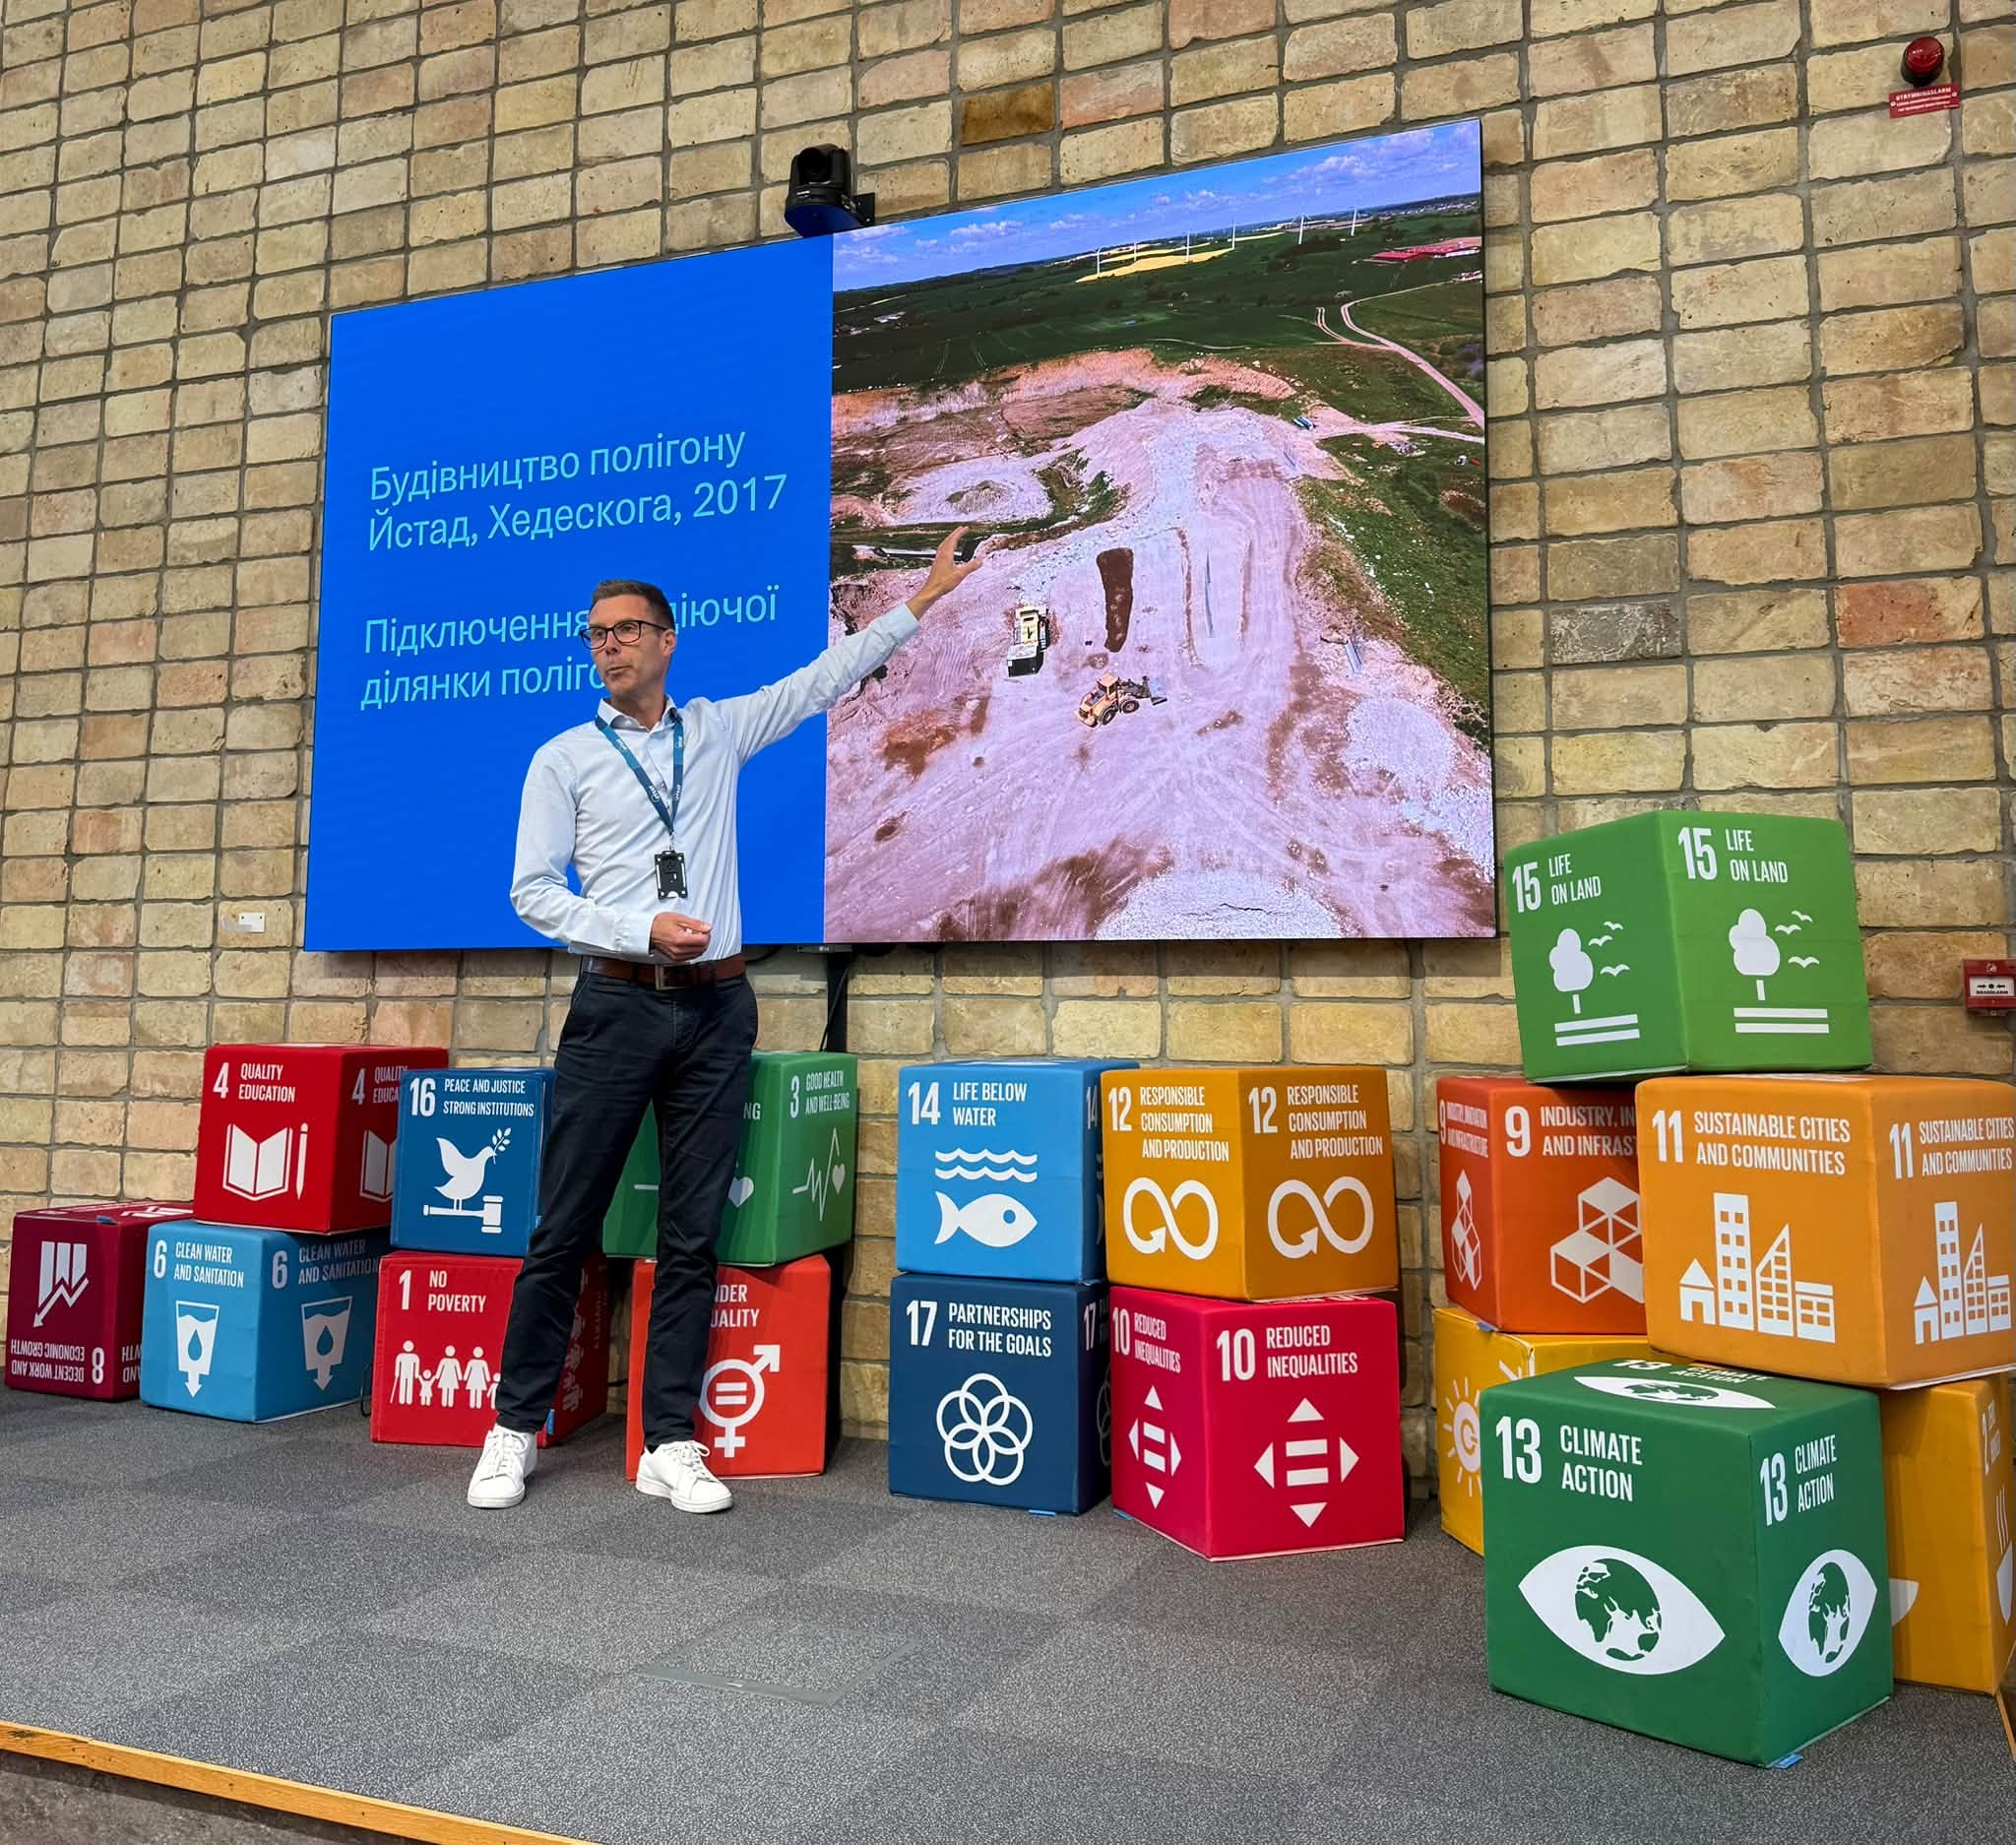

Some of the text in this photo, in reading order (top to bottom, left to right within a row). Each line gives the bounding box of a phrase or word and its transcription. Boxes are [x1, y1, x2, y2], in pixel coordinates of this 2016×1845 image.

[370, 431, 746, 506] Будівництво полігону
[369, 474, 787, 551] Йстад, Хедескога, 2017
[365, 609, 591, 657] Підключення
[360, 656, 605, 711] ділянки поліго
[1677, 826, 1754, 880] 15 LIFE
[1730, 859, 1789, 883] ON LAND
[1512, 854, 1572, 914] 15 LIFE
[1551, 875, 1602, 905] ON LAND
[213, 1062, 284, 1099] 4 QUALITY
[238, 1084, 295, 1103] EDUCATION
[351, 1068, 366, 1105] 4
[373, 1087, 400, 1104] EDUCA
[410, 1077, 526, 1116] 16 PEACE AND JUSTICE
[790, 1070, 844, 1118] 3 GOOD HEALTH
[443, 1101, 535, 1117] STRONG INSTITUTIONS
[805, 1092, 850, 1114] AND WELL-BEING
[908, 1081, 1028, 1125] 14 LIFE BELOW
[953, 1107, 996, 1126] WATER
[1086, 1084, 1098, 1130] 14
[1108, 1087, 1205, 1131] 12 RESPONSIBLE
[1248, 1084, 1358, 1134] 12 RESPONSIBLE
[1289, 1111, 1367, 1132] CONSUMPTION
[1141, 1113, 1213, 1133] CONSUMPTION
[1504, 1105, 1531, 1158] 9
[1653, 1110, 1683, 1163] 11
[1694, 1111, 1796, 1139] SUSTAINABLE
[1800, 1116, 1851, 1143] CITIES
[1142, 1138, 1228, 1162] AND PRODUCTION
[1291, 1136, 1383, 1160] AND PRODUCTION
[1543, 1135, 1575, 1156] AND
[1696, 1142, 1846, 1176] AND COMMUNITIES
[1890, 1116, 2015, 1179] 11 SUSTAINABLE CITIES
[1922, 1148, 2013, 1177] AND COMMUNITIES
[154, 1240, 232, 1278] 6 CLEAN WATER
[173, 1264, 244, 1289] AND SANITATION
[272, 1239, 366, 1289] 6 CLEAN WATER
[298, 1268, 320, 1285] AND
[399, 1270, 447, 1310] 1 NO
[428, 1294, 486, 1313] POVERTY
[710, 1308, 760, 1328] UALITY
[906, 1300, 1051, 1347] 17 PARTNERSHIPS
[1084, 1302, 1097, 1351] 17
[1112, 1306, 1130, 1355] 10
[1134, 1311, 1166, 1341] REDUCED
[11, 1339, 85, 1362] ECONOMIC GROWTH
[948, 1329, 1051, 1358] FOR THE GOALS
[1135, 1339, 1180, 1373] INEQUALITIES
[1217, 1325, 1331, 1381] 10 REDUCED
[11, 1360, 28, 1375] AND
[29, 1362, 52, 1378] WORK
[53, 1364, 85, 1383] DECENT
[92, 1347, 104, 1384] 8
[1267, 1352, 1357, 1378] INEQUALITIES
[1495, 1416, 1643, 1484] 13 CLIMATE
[1561, 1462, 1633, 1501] ACTION
[1760, 1434, 1837, 1526] 13 CLIMATE
[1797, 1473, 1834, 1512] ACTION
